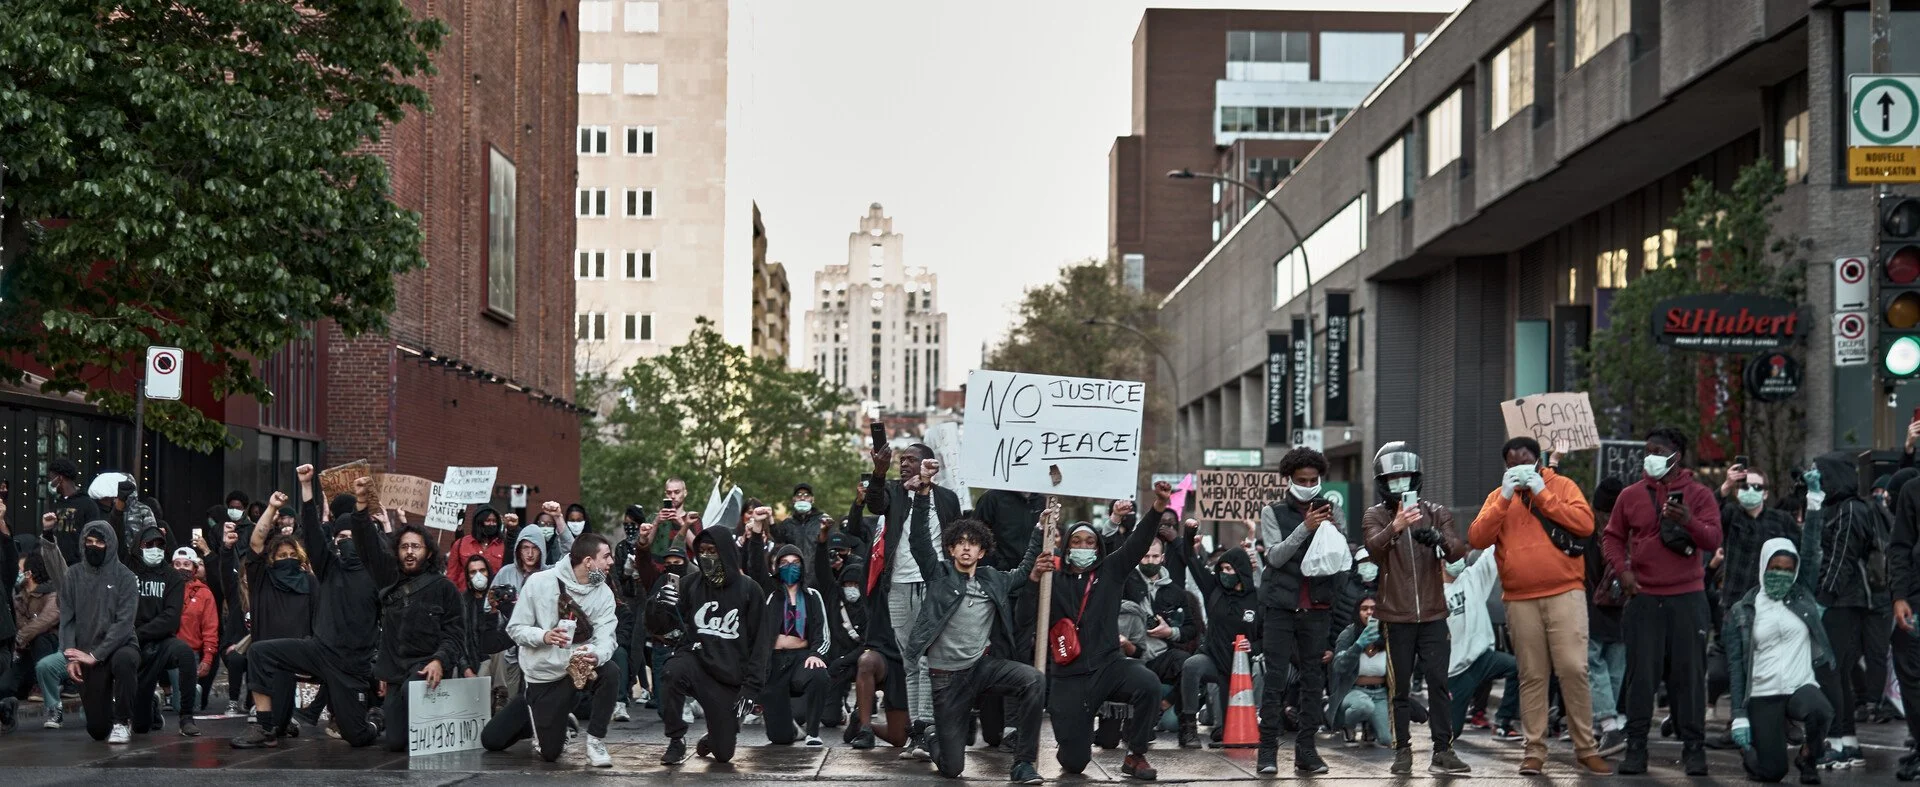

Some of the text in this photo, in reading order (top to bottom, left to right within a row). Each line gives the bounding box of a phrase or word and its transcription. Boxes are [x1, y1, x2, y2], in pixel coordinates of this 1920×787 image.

[1865, 153, 1904, 162] NOUVELLE
[1855, 166, 1916, 176] SIGNALISATION
[1329, 315, 1341, 399] WINNERS
[1270, 352, 1281, 425] WINNERS
[1294, 340, 1306, 416] WINNERS
[983, 375, 1042, 430] NO
[993, 436, 1034, 482] NO
[1041, 428, 1139, 456] PEACE!
[1200, 473, 1223, 486] WHO
[1226, 473, 1240, 487] DO
[1241, 473, 1260, 487] YOU
[388, 498, 425, 510] MURDER
[1200, 487, 1285, 501] WHEN THE CRIMINAL
[1199, 500, 1242, 519] WEAR
[410, 722, 455, 752] BREATHE
